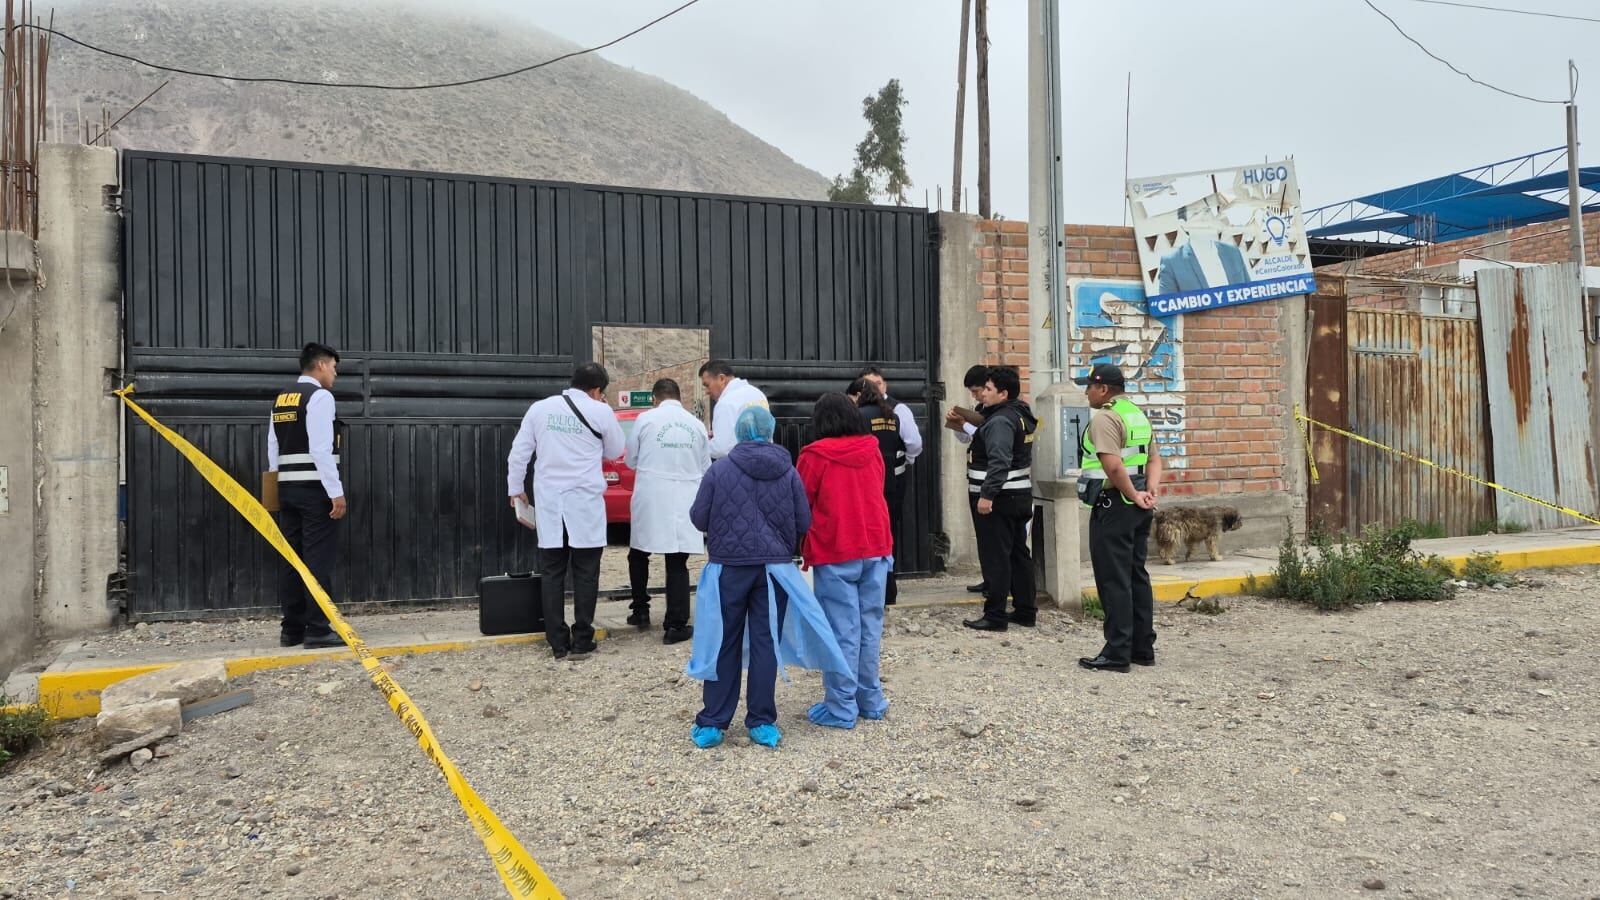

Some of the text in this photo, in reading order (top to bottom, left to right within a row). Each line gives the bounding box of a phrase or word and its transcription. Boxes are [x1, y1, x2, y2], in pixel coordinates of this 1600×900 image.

[1243, 166, 1288, 184] HUGO
[1264, 255, 1293, 266] ALCALDE
[1214, 291, 1224, 304] Y
